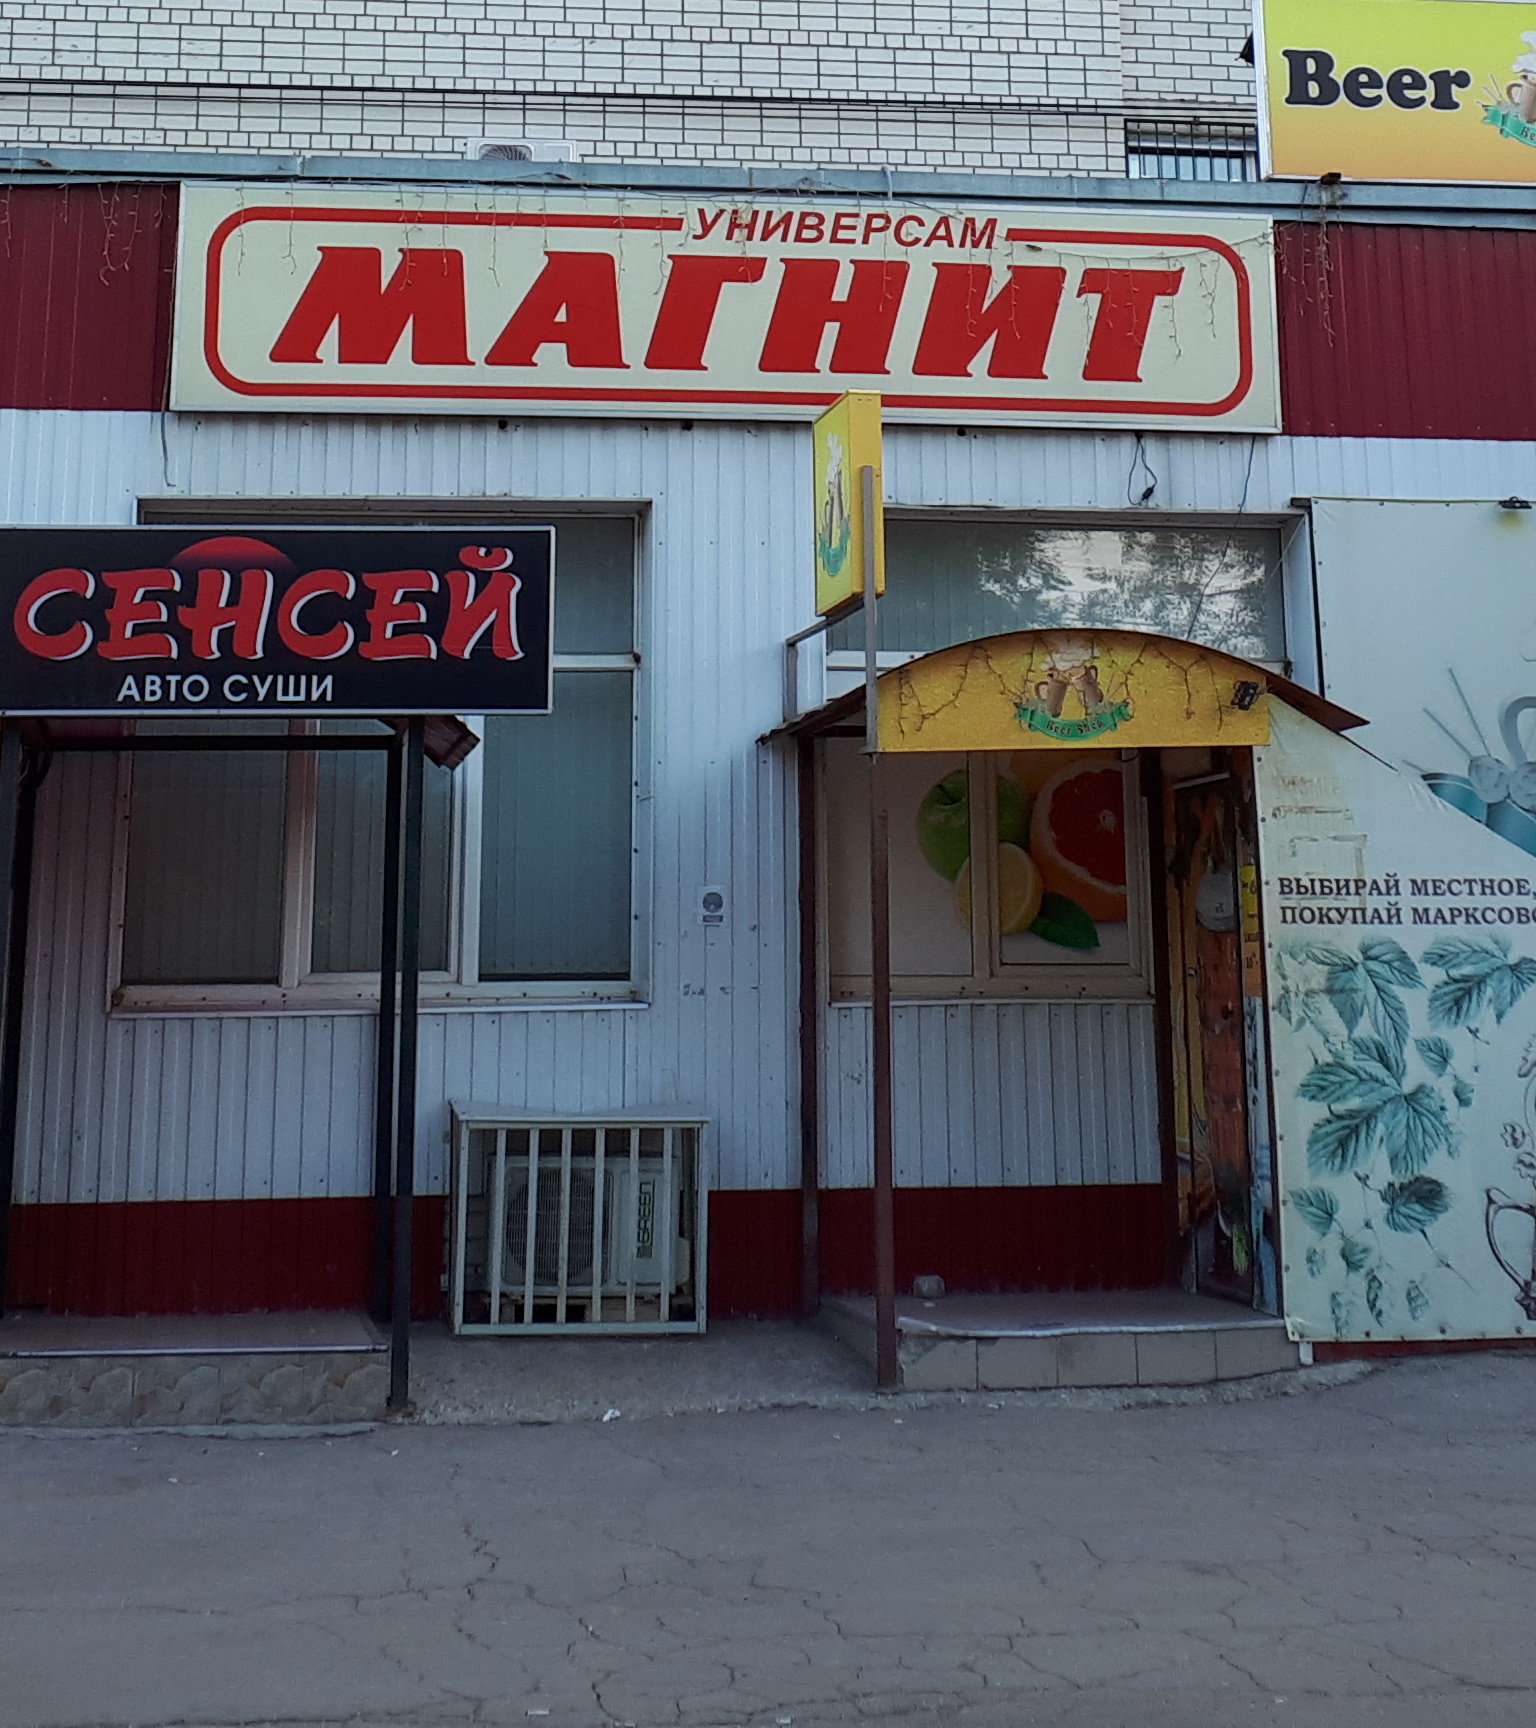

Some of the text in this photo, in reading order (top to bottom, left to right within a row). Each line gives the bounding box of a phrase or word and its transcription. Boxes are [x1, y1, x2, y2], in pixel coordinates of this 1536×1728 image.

[1280, 48, 1471, 111] Beer
[692, 207, 999, 249] УНИВЕРСАМ
[269, 245, 1185, 382] МАГНИТ
[13, 544, 525, 661] СЕНСЕЙ
[117, 674, 333, 703] АВТО СУШИ
[1046, 720, 1071, 734] Beer
[1278, 873, 1400, 896] ВЫБИРАЙ
[1280, 902, 1402, 925] ПОКУПАЙ
